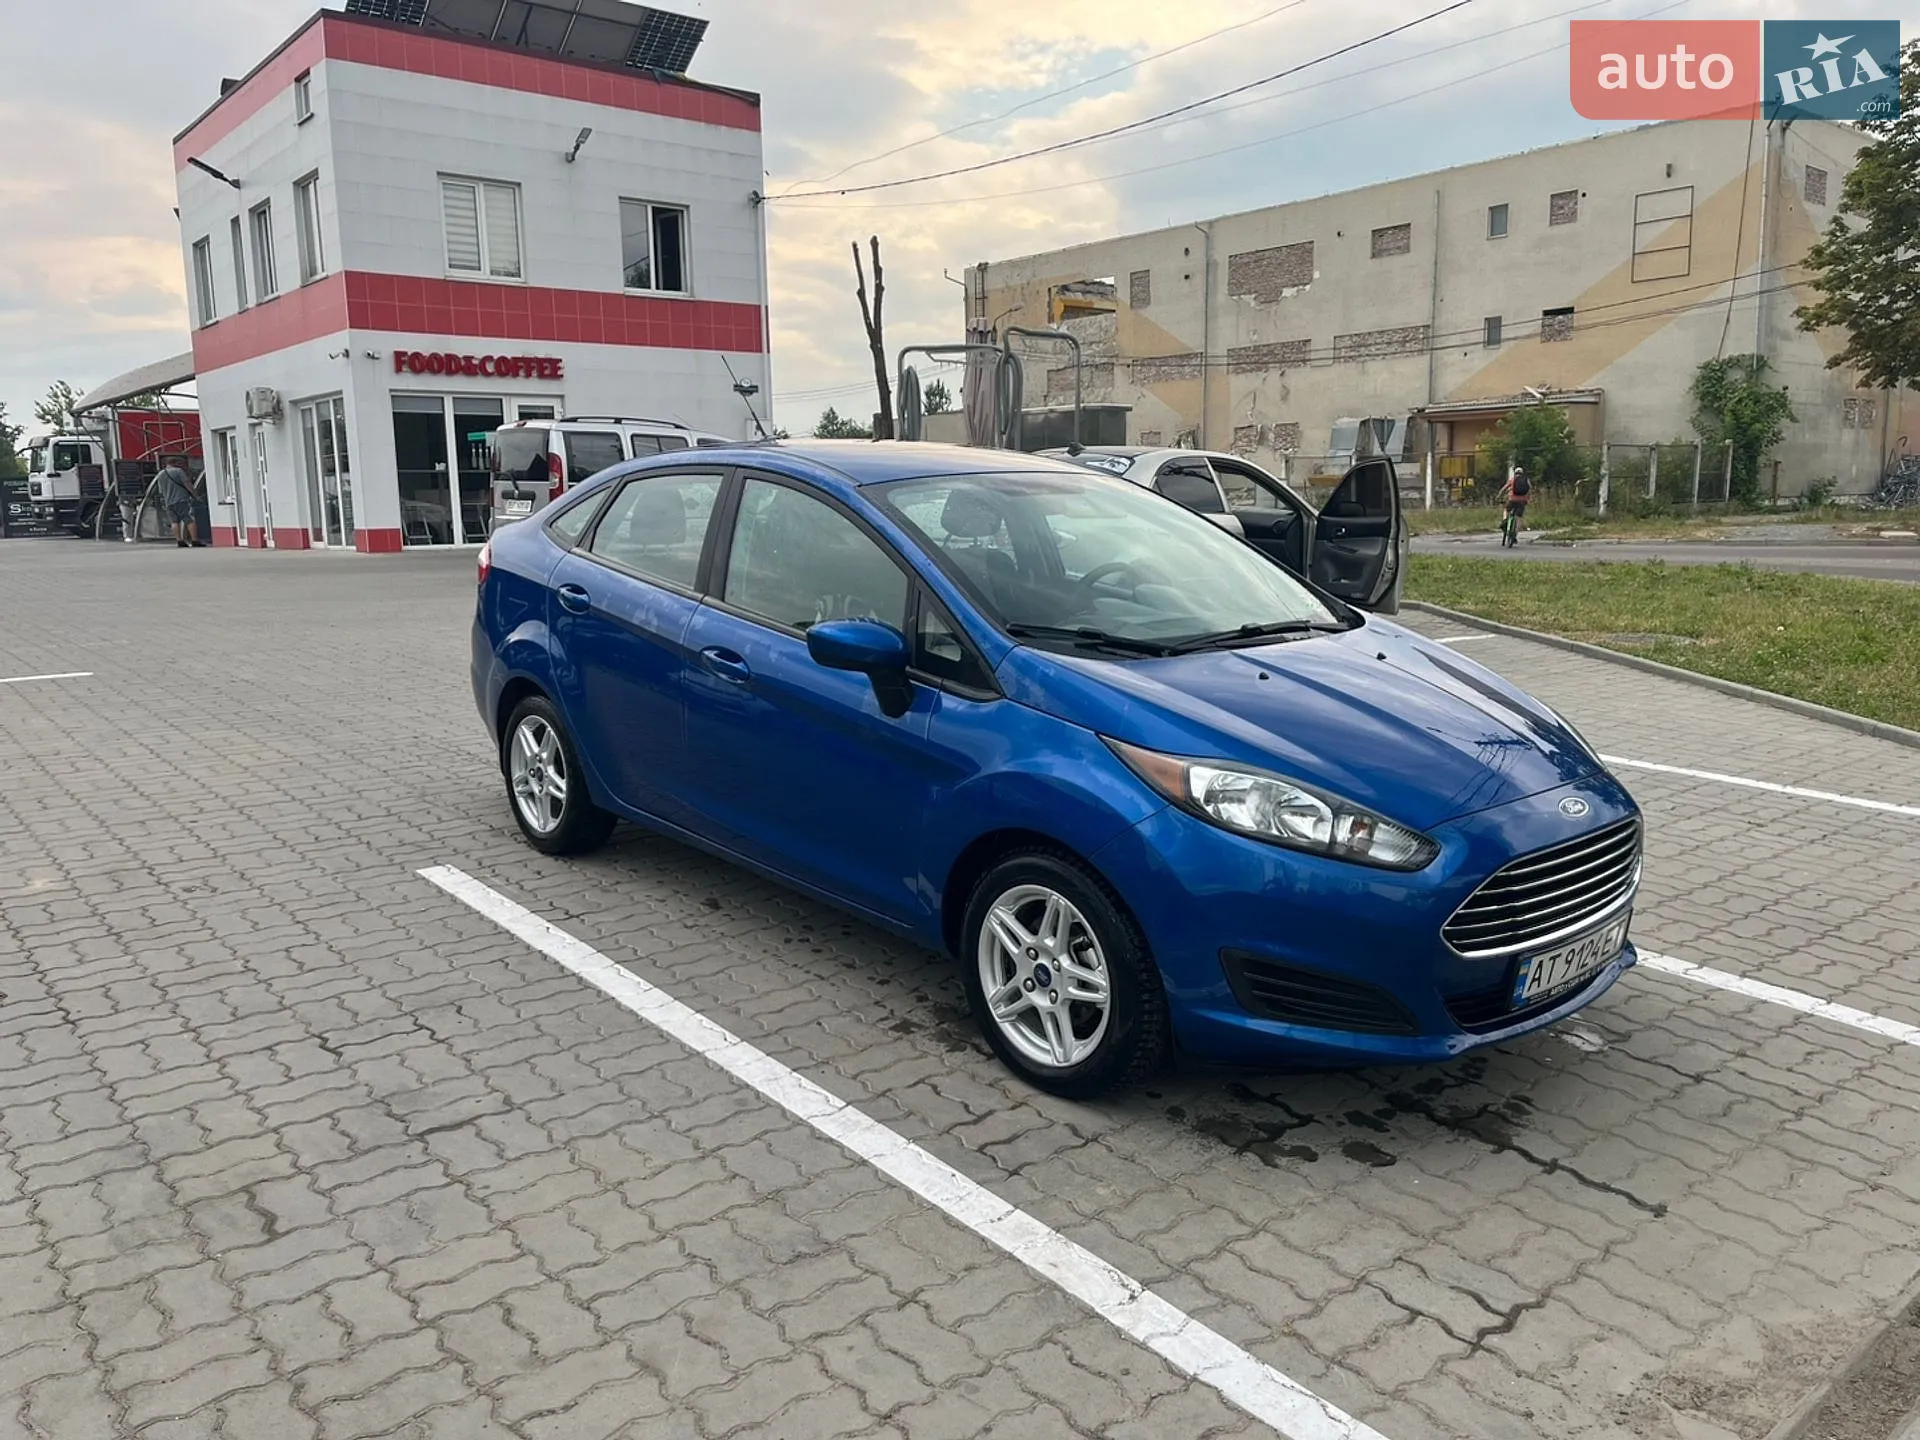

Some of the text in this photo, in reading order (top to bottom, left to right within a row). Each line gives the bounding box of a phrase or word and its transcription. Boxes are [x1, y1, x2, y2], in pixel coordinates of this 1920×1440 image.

[393, 350, 564, 380] FOOD&COFFEE
[1527, 952, 1561, 992] AT
[1561, 933, 1603, 979] 9124
